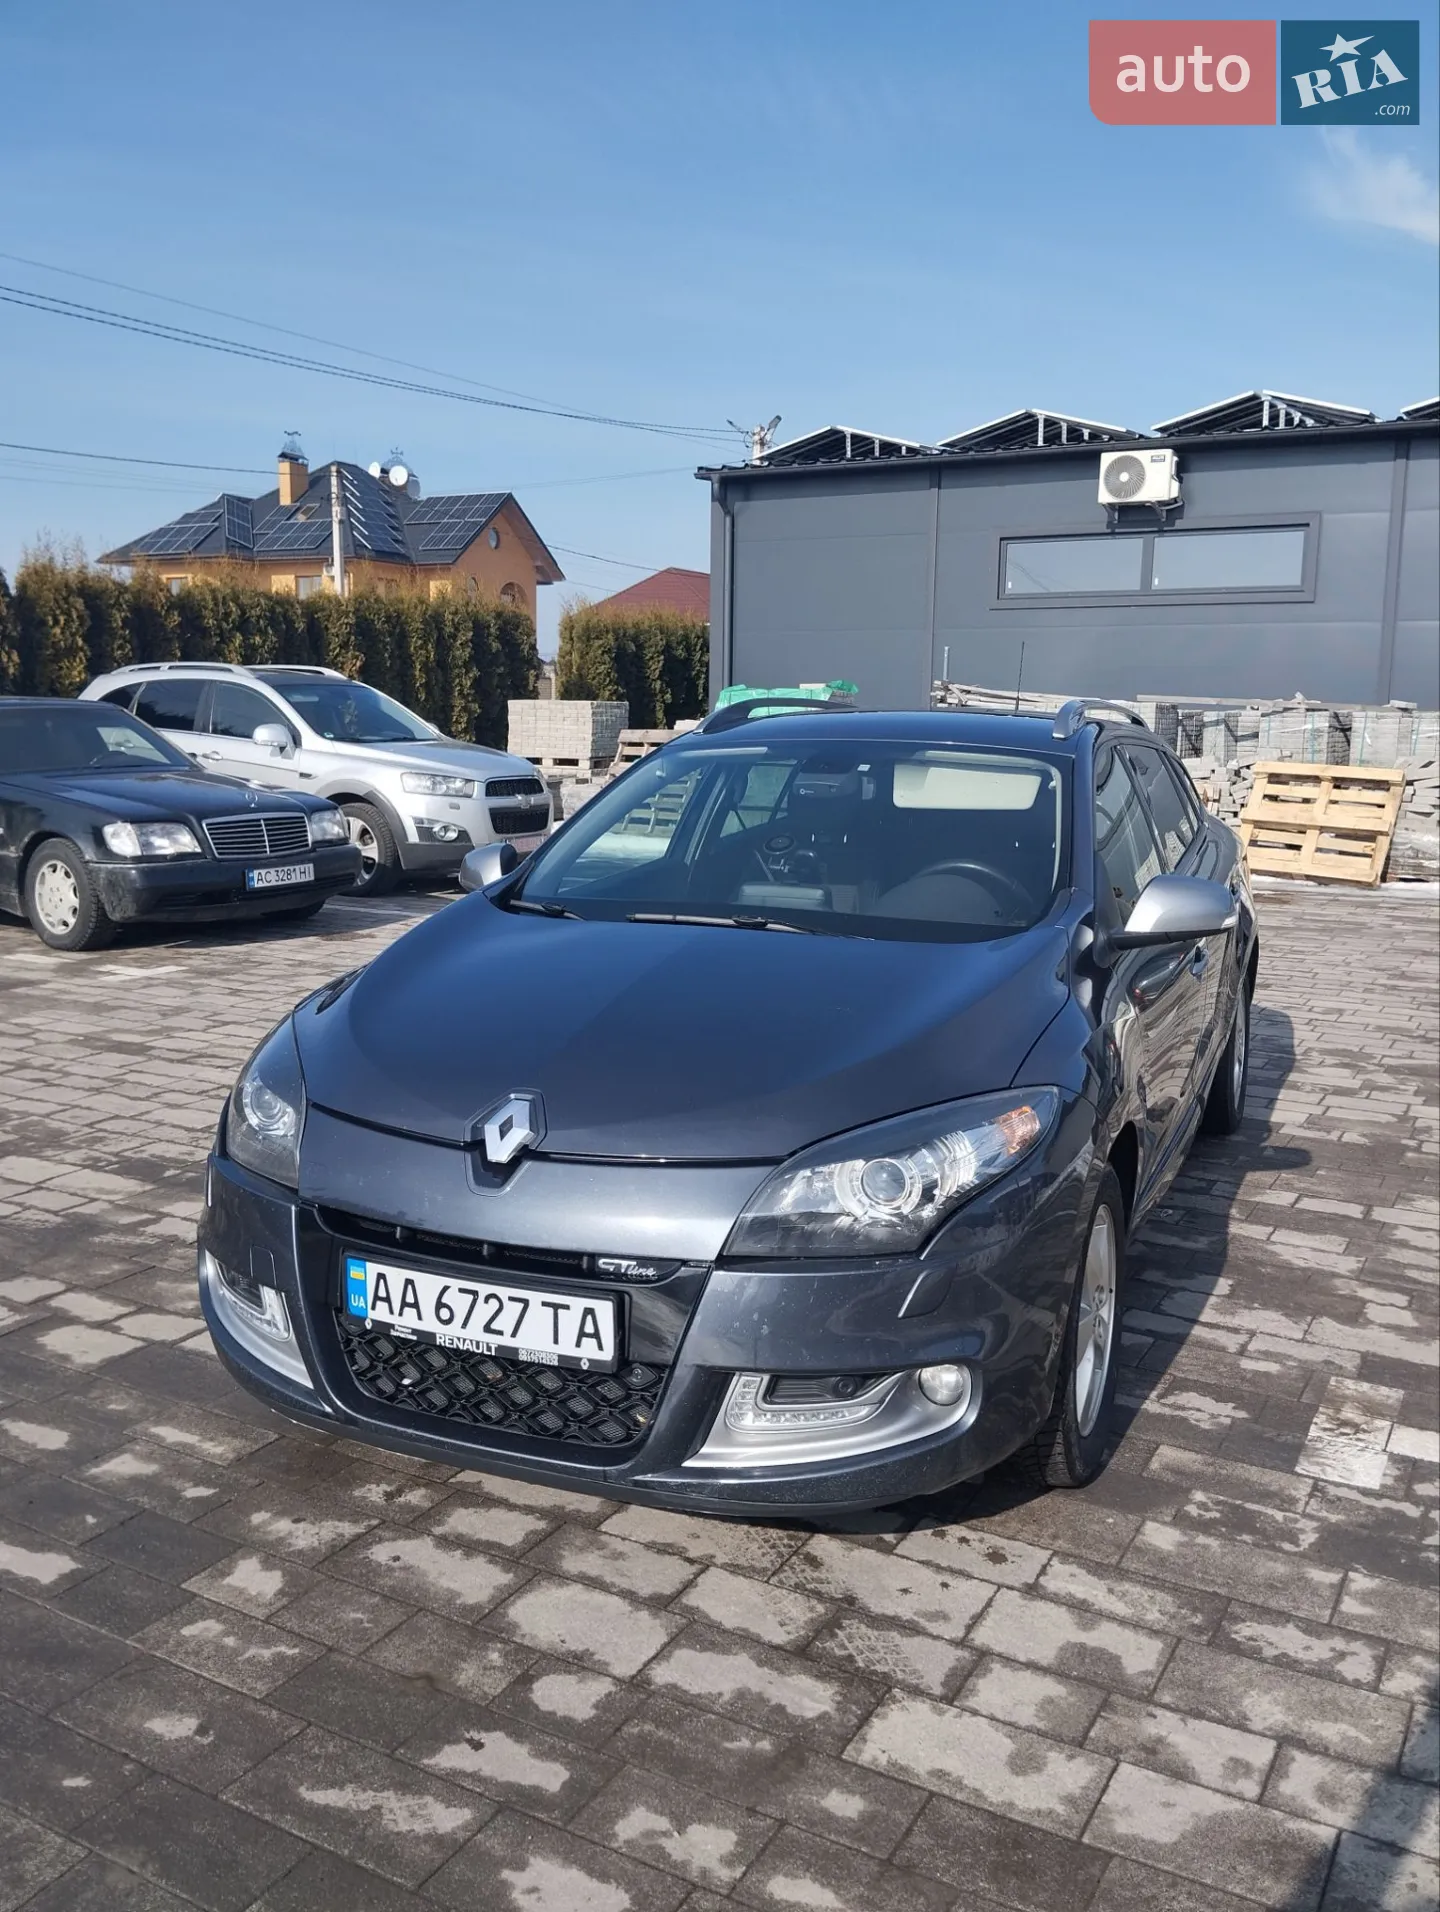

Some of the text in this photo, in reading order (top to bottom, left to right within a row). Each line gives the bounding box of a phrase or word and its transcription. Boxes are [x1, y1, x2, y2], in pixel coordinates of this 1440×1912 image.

[258, 872, 272, 884] AC
[276, 868, 297, 882] 3281
[350, 1293, 367, 1310] UA
[371, 1272, 605, 1352] AA 6727 TA
[436, 1333, 499, 1356] RENAULT
